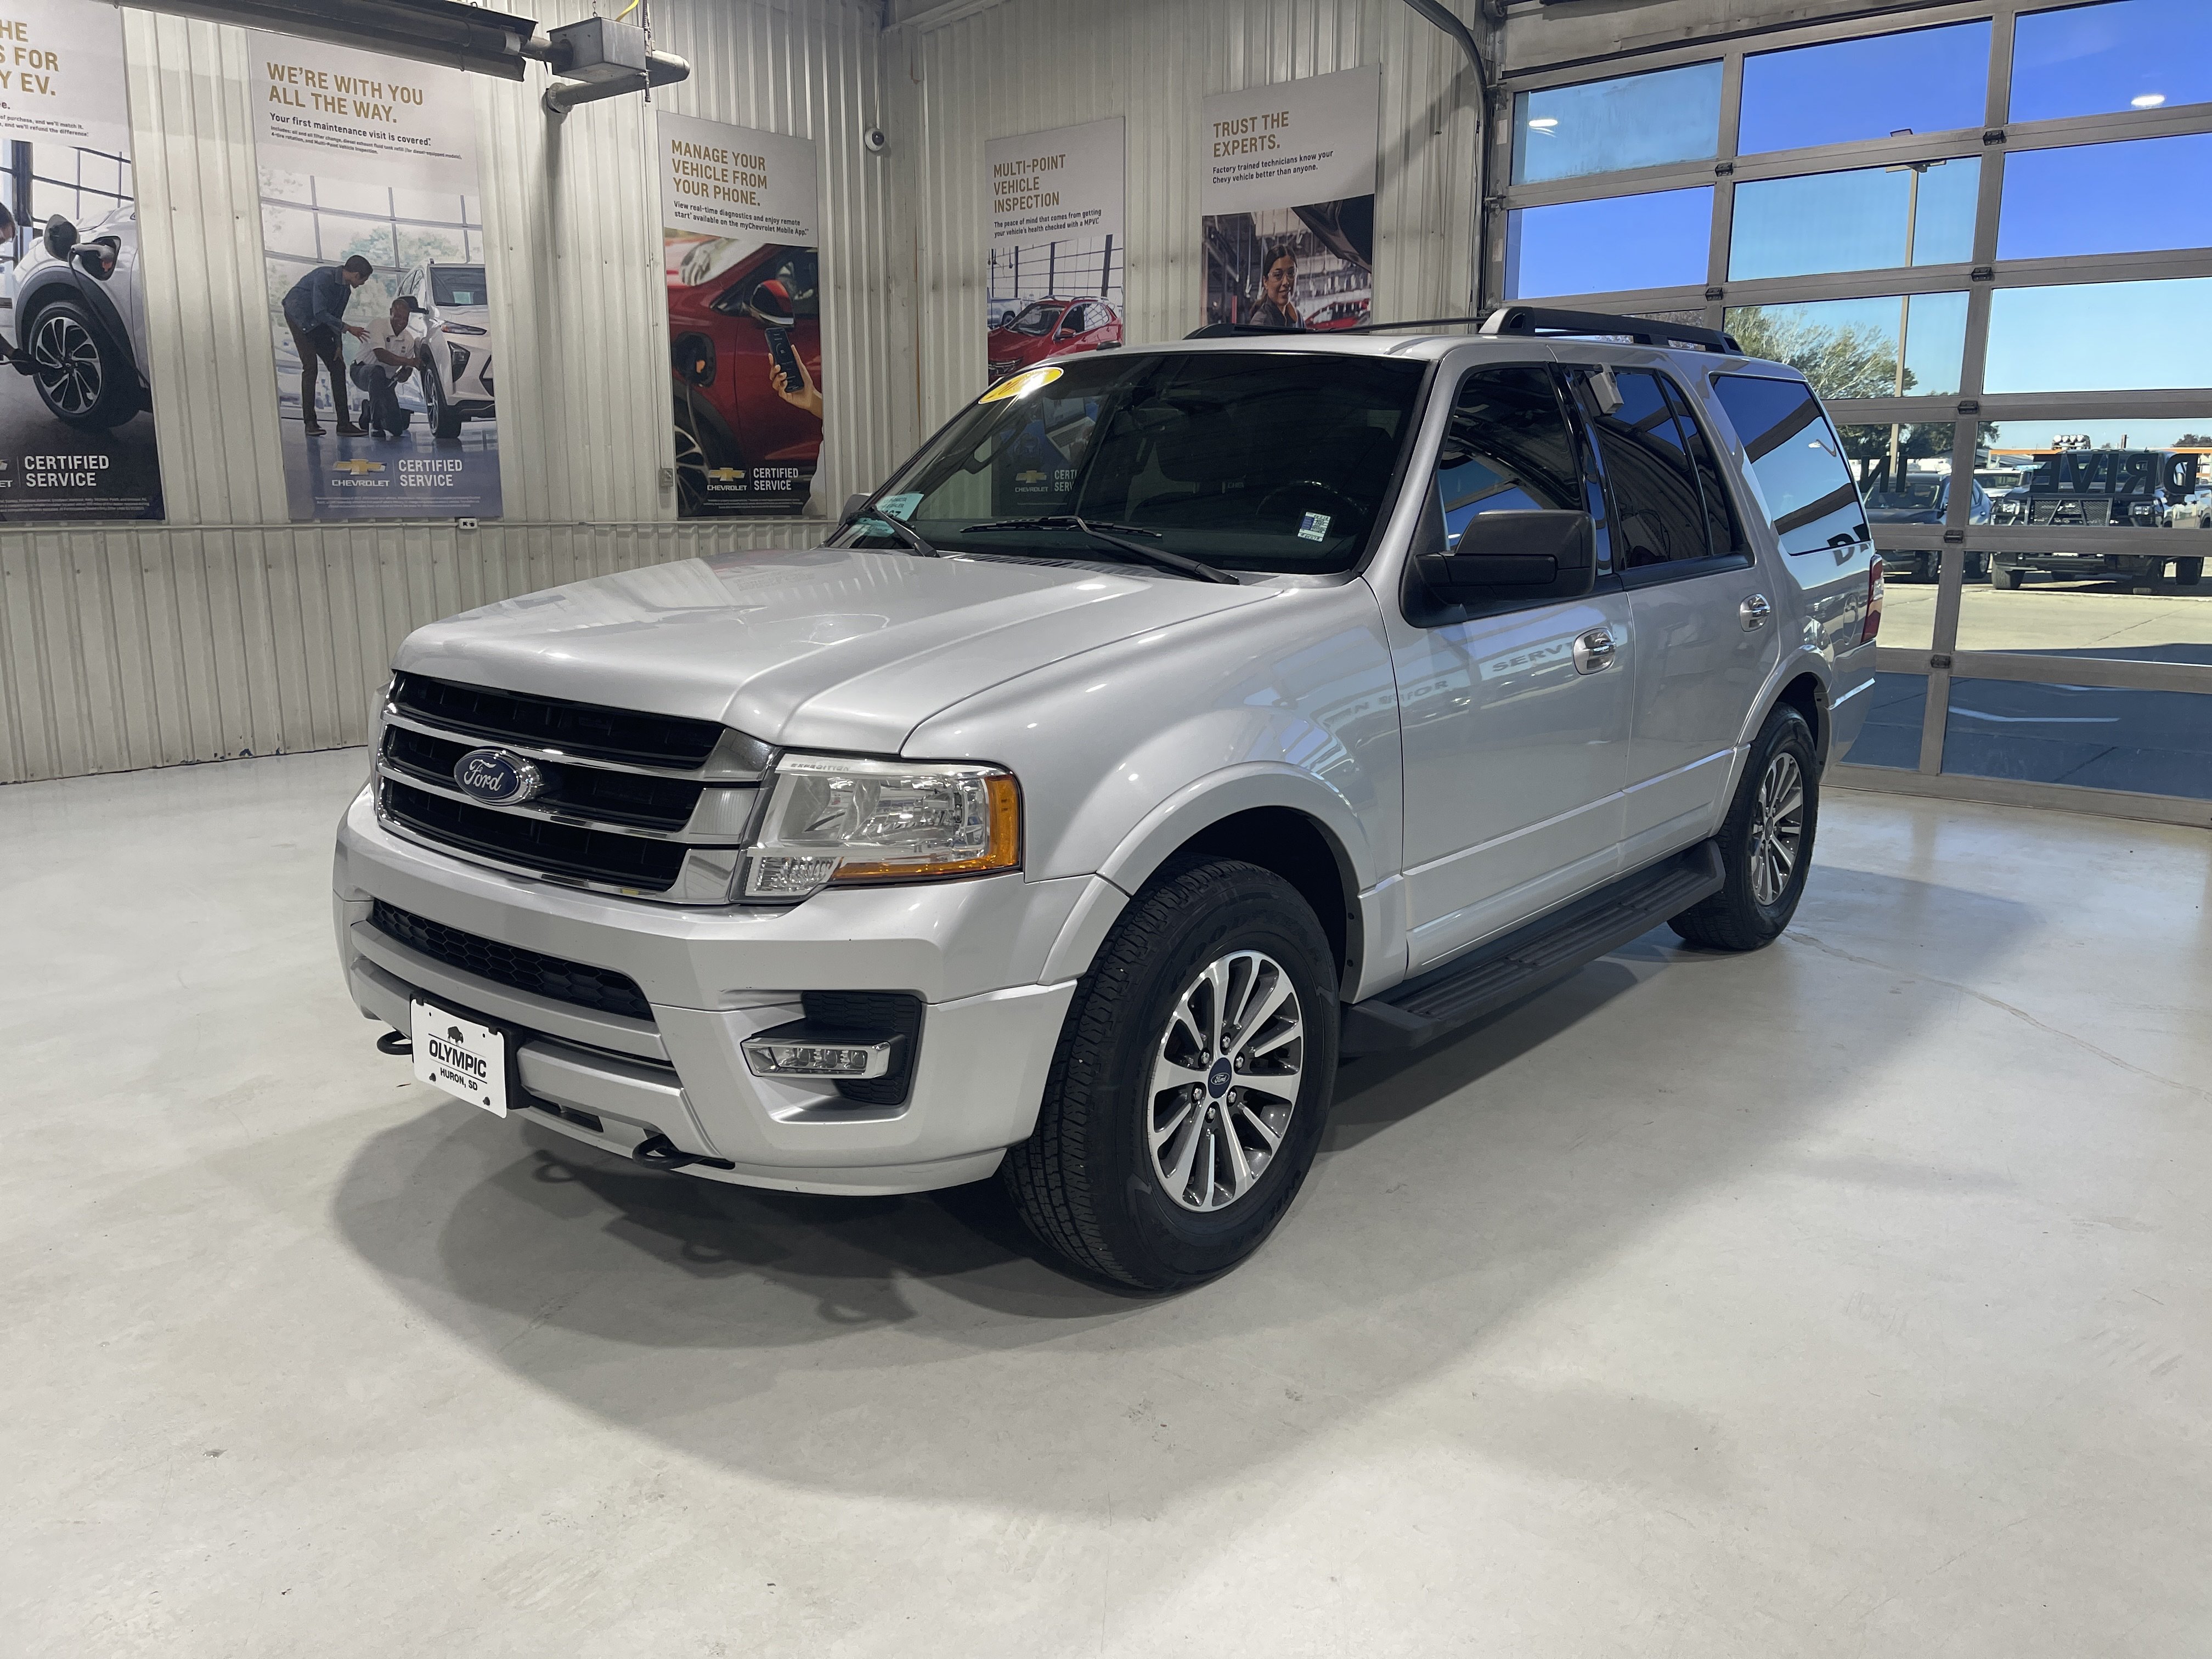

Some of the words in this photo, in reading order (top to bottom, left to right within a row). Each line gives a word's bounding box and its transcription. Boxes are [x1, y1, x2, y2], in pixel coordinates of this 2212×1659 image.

[0, 19, 29, 42] HE
[14, 47, 59, 72] FOR
[21, 72, 56, 95] EV.
[267, 62, 328, 89] WE'RE
[334, 75, 382, 99] WITH
[388, 84, 423, 106] YOU
[269, 85, 306, 108] ALL
[311, 93, 348, 115] THE
[353, 100, 397, 123] WAY.
[270, 112, 290, 123] Your
[292, 116, 311, 127] first
[314, 122, 367, 137] maintenance
[369, 130, 386, 140] visit
[388, 133, 395, 141] is
[1214, 116, 1257, 138] TRUST
[1262, 111, 1289, 131] THE
[672, 139, 728, 165] MANAGE
[732, 151, 766, 171] YOUR
[1214, 134, 1280, 157] EXPERTS.
[994, 154, 1066, 178] MULTI-POINT
[1213, 166, 1236, 174] Factory
[1238, 161, 1260, 171] trained
[1261, 156, 1297, 168] technicians
[1299, 153, 1317, 162] know
[1318, 150, 1334, 160] your
[1233, 172, 1254, 182] vehicle
[1256, 169, 1276, 179] better
[1277, 168, 1291, 176] than
[1293, 165, 1318, 174] anyone.
[672, 159, 729, 183] VEHICLE
[733, 170, 767, 189] FROM
[994, 176, 1040, 195] VEHICLE
[673, 177, 709, 198] YOUR
[714, 185, 760, 206] PHONE.
[995, 191, 1059, 213] INSPECTION
[674, 200, 689, 210] View
[690, 205, 718, 215] real-time
[719, 209, 752, 220] diagnostics
[765, 216, 780, 225] enjoy
[693, 214, 719, 224] available
[740, 222, 775, 232] myChevrolet
[776, 225, 794, 234] Mobile
[1004, 220, 1019, 228] peace
[1082, 209, 1102, 219] getting
[1006, 227, 1027, 235] vehicle's
[1028, 225, 1043, 233] health
[1045, 222, 1066, 231] checked
[24, 455, 110, 470] CERTIFIED
[398, 459, 462, 472] CERTIFIED
[753, 467, 799, 478] CERTIFIED
[26, 472, 97, 487] SERVICE
[399, 475, 453, 487] SERVICE
[754, 480, 792, 490] SERVICE
[1054, 469, 1077, 480] CERTI
[1054, 481, 1075, 492] SERV
[464, 759, 504, 792] Ford
[429, 1040, 487, 1078] OLYMPIC
[440, 1068, 467, 1088] HURON,
[468, 1080, 478, 1091] SD
